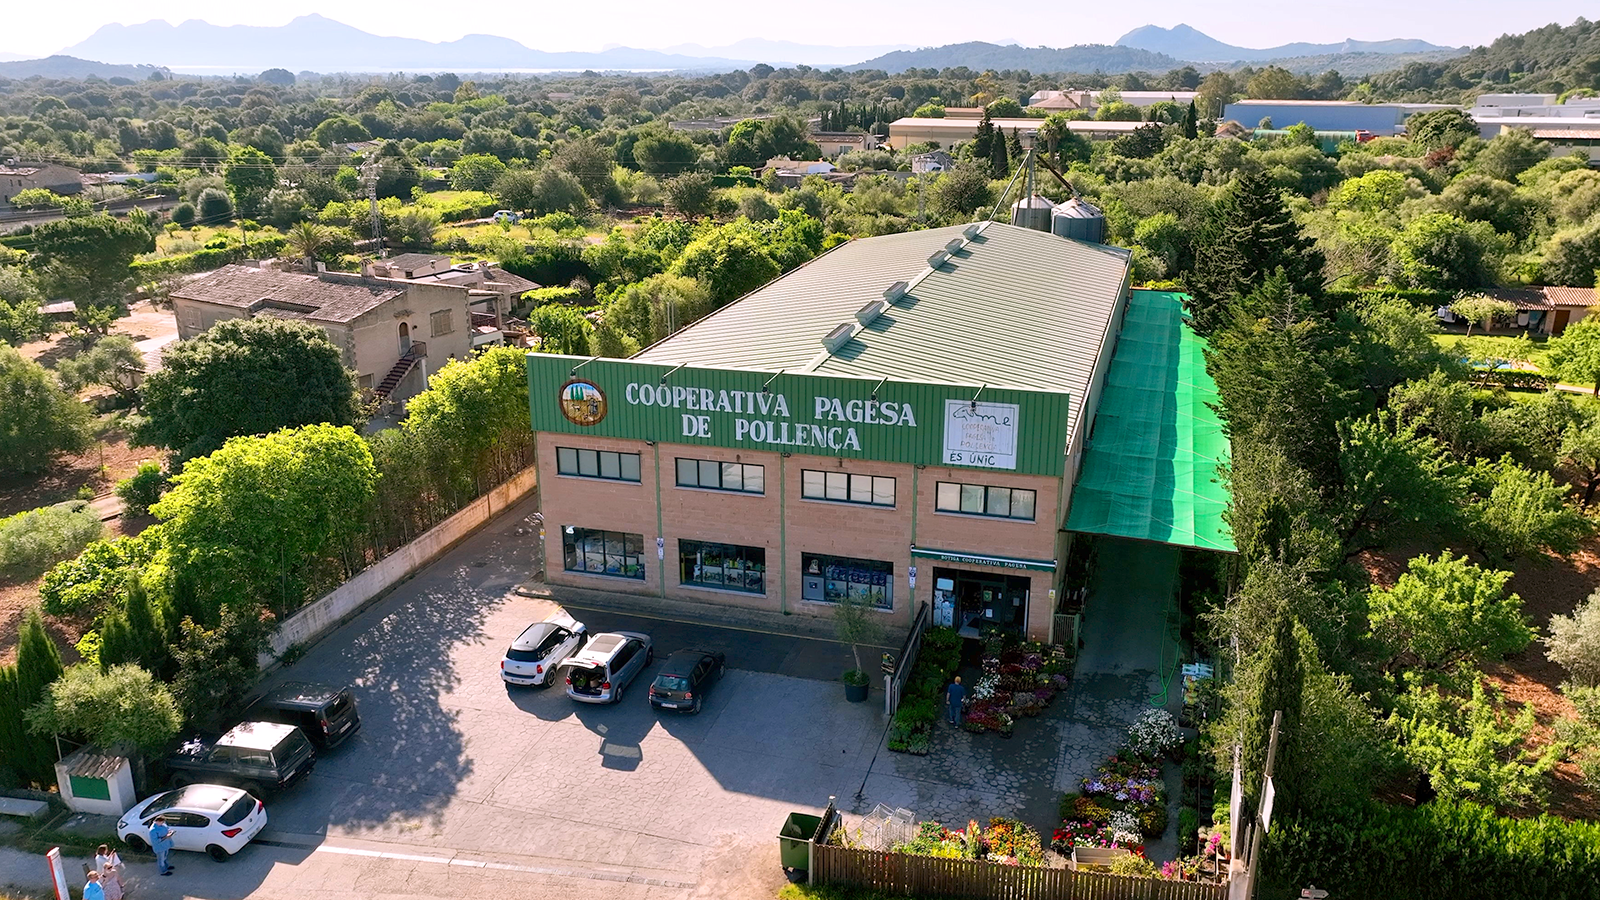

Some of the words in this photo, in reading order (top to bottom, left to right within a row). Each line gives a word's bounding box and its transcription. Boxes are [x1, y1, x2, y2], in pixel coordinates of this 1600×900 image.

[625, 382, 790, 417] COOPERATIVA
[814, 396, 917, 427] PAGESA
[681, 414, 711, 438] DE
[735, 418, 861, 453] POLLENÇA
[962, 557, 1000, 566] COOPERATIVA
